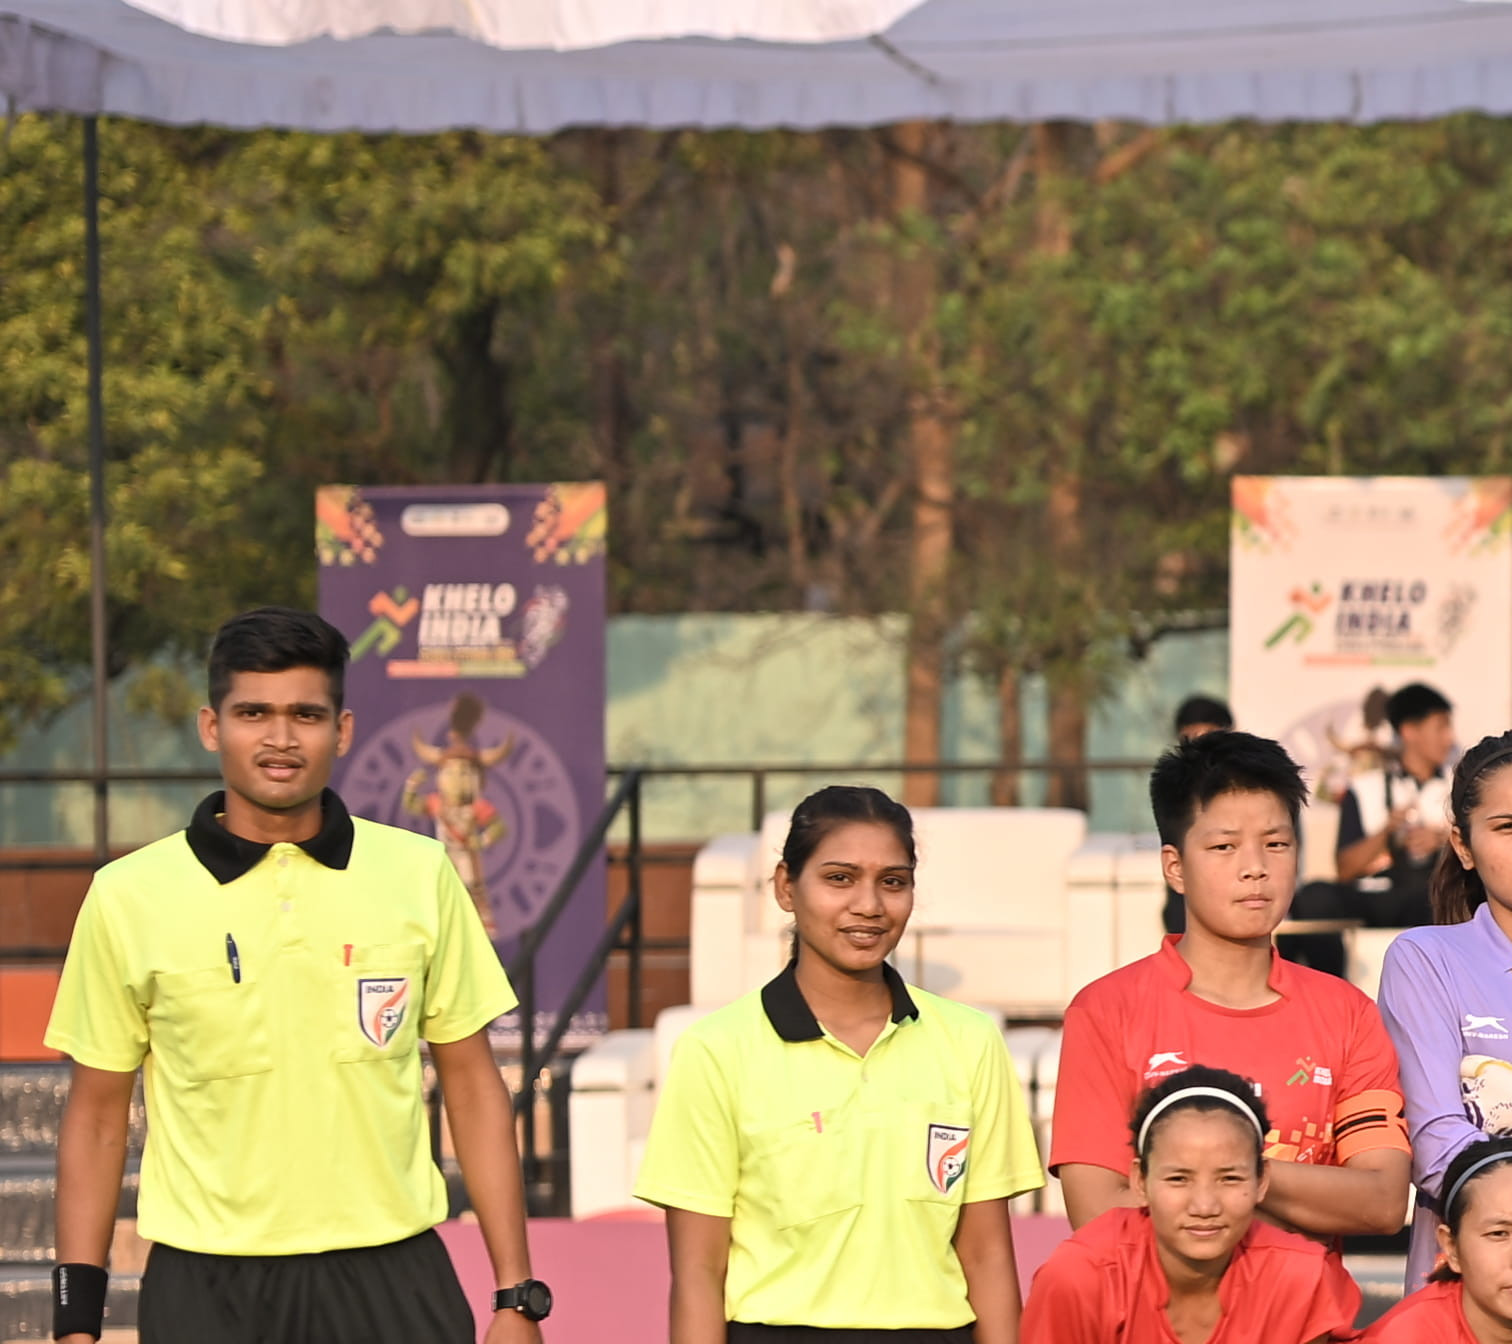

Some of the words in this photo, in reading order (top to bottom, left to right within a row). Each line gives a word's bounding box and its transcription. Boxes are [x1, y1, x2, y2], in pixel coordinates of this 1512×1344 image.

[423, 582, 516, 616] KHELO
[1341, 583, 1427, 605] KHELO
[419, 613, 501, 646] INDIA
[1337, 613, 1412, 637] INDIA
[367, 984, 394, 994] INDIA
[933, 1130, 958, 1142] INDIA
